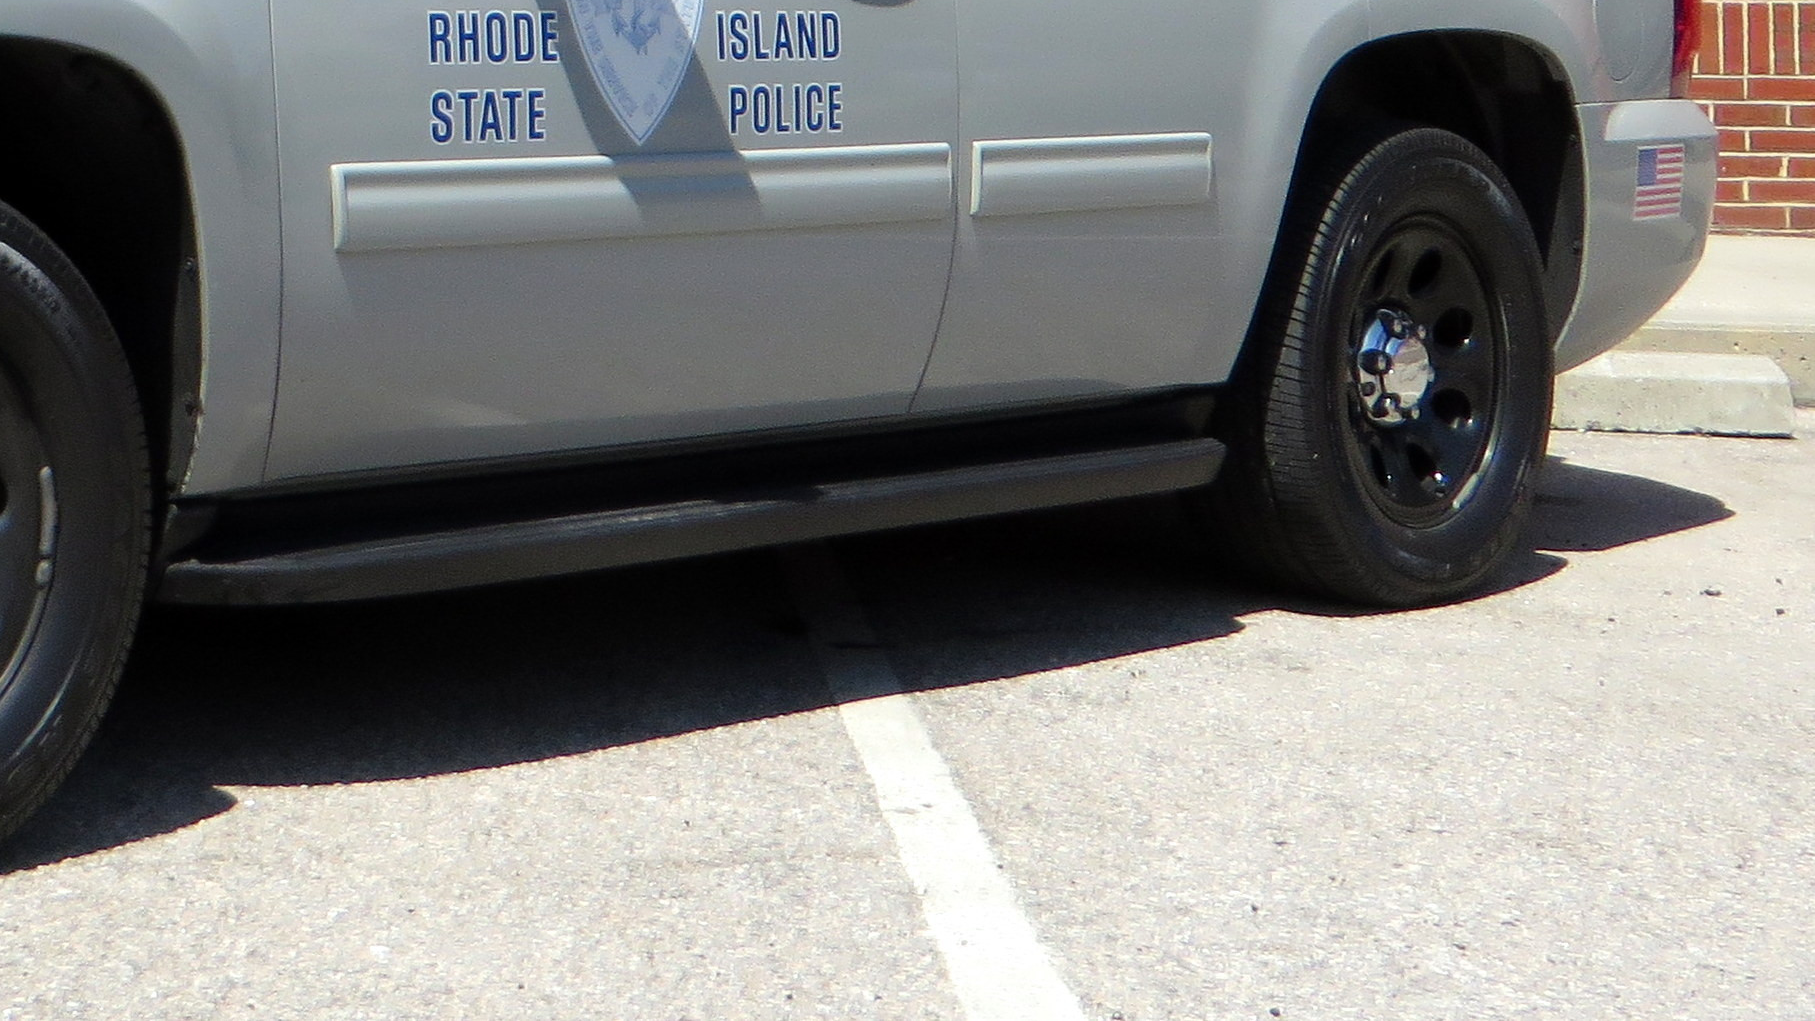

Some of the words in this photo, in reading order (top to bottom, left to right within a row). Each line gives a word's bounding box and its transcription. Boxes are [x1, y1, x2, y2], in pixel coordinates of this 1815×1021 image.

[427, 10, 559, 65] RHODE
[715, 10, 841, 61] ISLAND
[430, 87, 546, 145] STATE
[728, 82, 843, 136] POLICE
